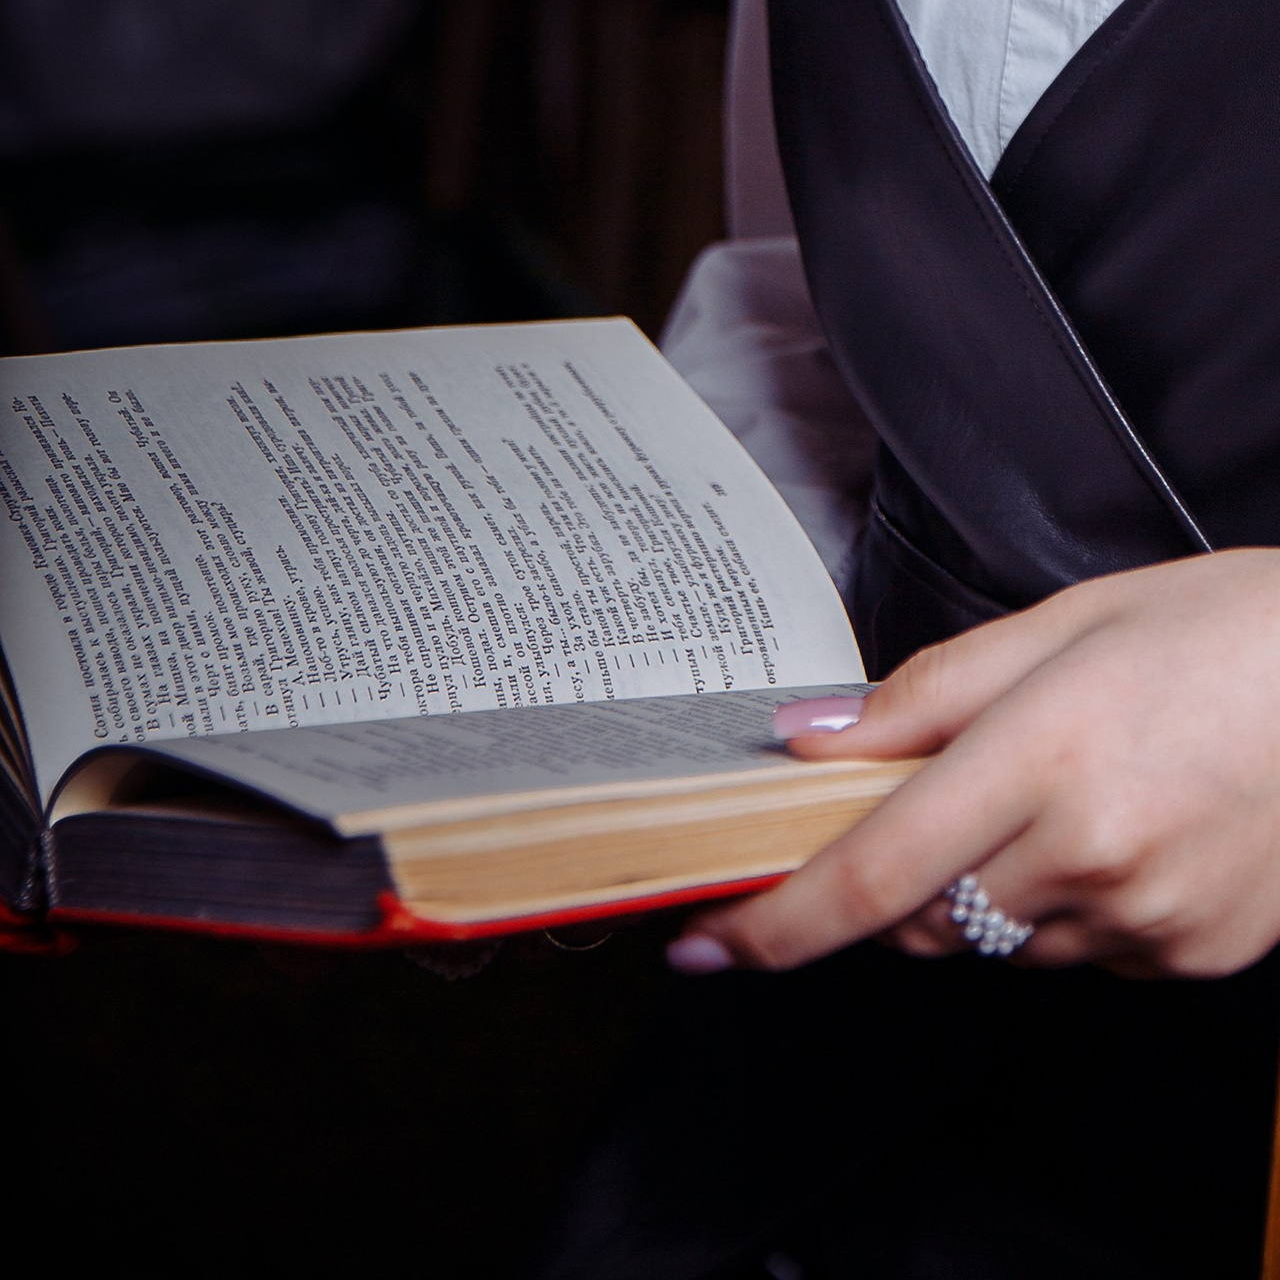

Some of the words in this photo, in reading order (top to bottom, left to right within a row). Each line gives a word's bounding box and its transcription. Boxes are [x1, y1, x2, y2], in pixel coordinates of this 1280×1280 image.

[637, 567, 650, 586] бы,
[648, 558, 675, 606] секанул,
[663, 558, 680, 585] твое,
[715, 546, 741, 586] верхом.
[748, 578, 759, 593] ее,
[296, 586, 316, 622] крове,
[313, 586, 336, 625] успею.
[326, 583, 342, 604] как
[358, 580, 386, 625] давался
[365, 563, 403, 631] выпользуют
[439, 580, 464, 621] концом
[452, 574, 480, 622] Острием
[471, 578, 485, 596] его
[522, 585, 539, 611] трое
[536, 584, 560, 625] было-к
[585, 589, 598, 604] ты
[598, 585, 615, 603] уж
[612, 578, 638, 629] четверть
[627, 578, 651, 620] забуду.
[704, 582, 717, 598] же
[107, 591, 135, 650] оказалось
[338, 607, 359, 646] гляну,
[347, 591, 370, 633] силком
[419, 605, 431, 620] на
[482, 601, 505, 648] смешав
[494, 592, 517, 634] плотно
[560, 601, 580, 629] уход
[572, 590, 591, 625] стало.
[606, 606, 629, 645] Какой
[647, 591, 667, 623] хотел
[677, 590, 702, 637] Счастье
[713, 602, 731, 633] Куда
[722, 596, 752, 654] Григорий
[756, 596, 773, 628] Кинь
[158, 630, 170, 645] на
[172, 622, 191, 650] двор
[186, 610, 205, 645] ними,
[204, 611, 228, 660] промок.
[223, 617, 237, 639] мое
[244, 626, 257, 646] где
[253, 608, 282, 670] Григорию
[267, 609, 298, 666] Мелехов!
[283, 595, 320, 682] Наполовинку.
[380, 629, 392, 650] что
[400, 599, 432, 668] спрашивая
[441, 615, 466, 665] Добудь,
[514, 603, 549, 677] улыбнулся:
[535, 617, 554, 654] Через
[559, 628, 571, 656] ты...
[573, 635, 585, 651] За
[587, 629, 599, 646] бы
[592, 608, 615, 646] Какой
[645, 624, 658, 641] Не
[672, 613, 688, 641] тебя
[737, 590, 775, 683] окровяненным
[68, 629, 94, 686] постояла
[105, 628, 126, 673] взвода,
[130, 654, 142, 669] не
[142, 635, 163, 676] глазах
[183, 654, 200, 681] этот
[232, 643, 254, 691] Возьми
[315, 637, 336, 682] Лоб-то
[331, 628, 352, 678] Утрусь,
[351, 650, 369, 676] Дай
[364, 639, 390, 699] Чубатый
[388, 654, 401, 673] На
[398, 635, 414, 664] тебя
[431, 635, 449, 669] пулю
[458, 627, 485, 686] Кошевой
[478, 629, 497, 670] подал.
[513, 642, 525, 657] он
[712, 645, 732, 688] чужой
[95, 651, 124, 728] собиралась
[167, 652, 189, 705] Мишка,
[204, 663, 220, 696] Черт
[222, 664, 239, 696] бинт
[253, 653, 273, 696] сарай,
[425, 673, 438, 693] Не
[685, 648, 703, 693] тупым
[120, 677, 140, 721] своего
[136, 673, 156, 714] сумах
[158, 684, 170, 703] На
[89, 695, 107, 738] Сотня
